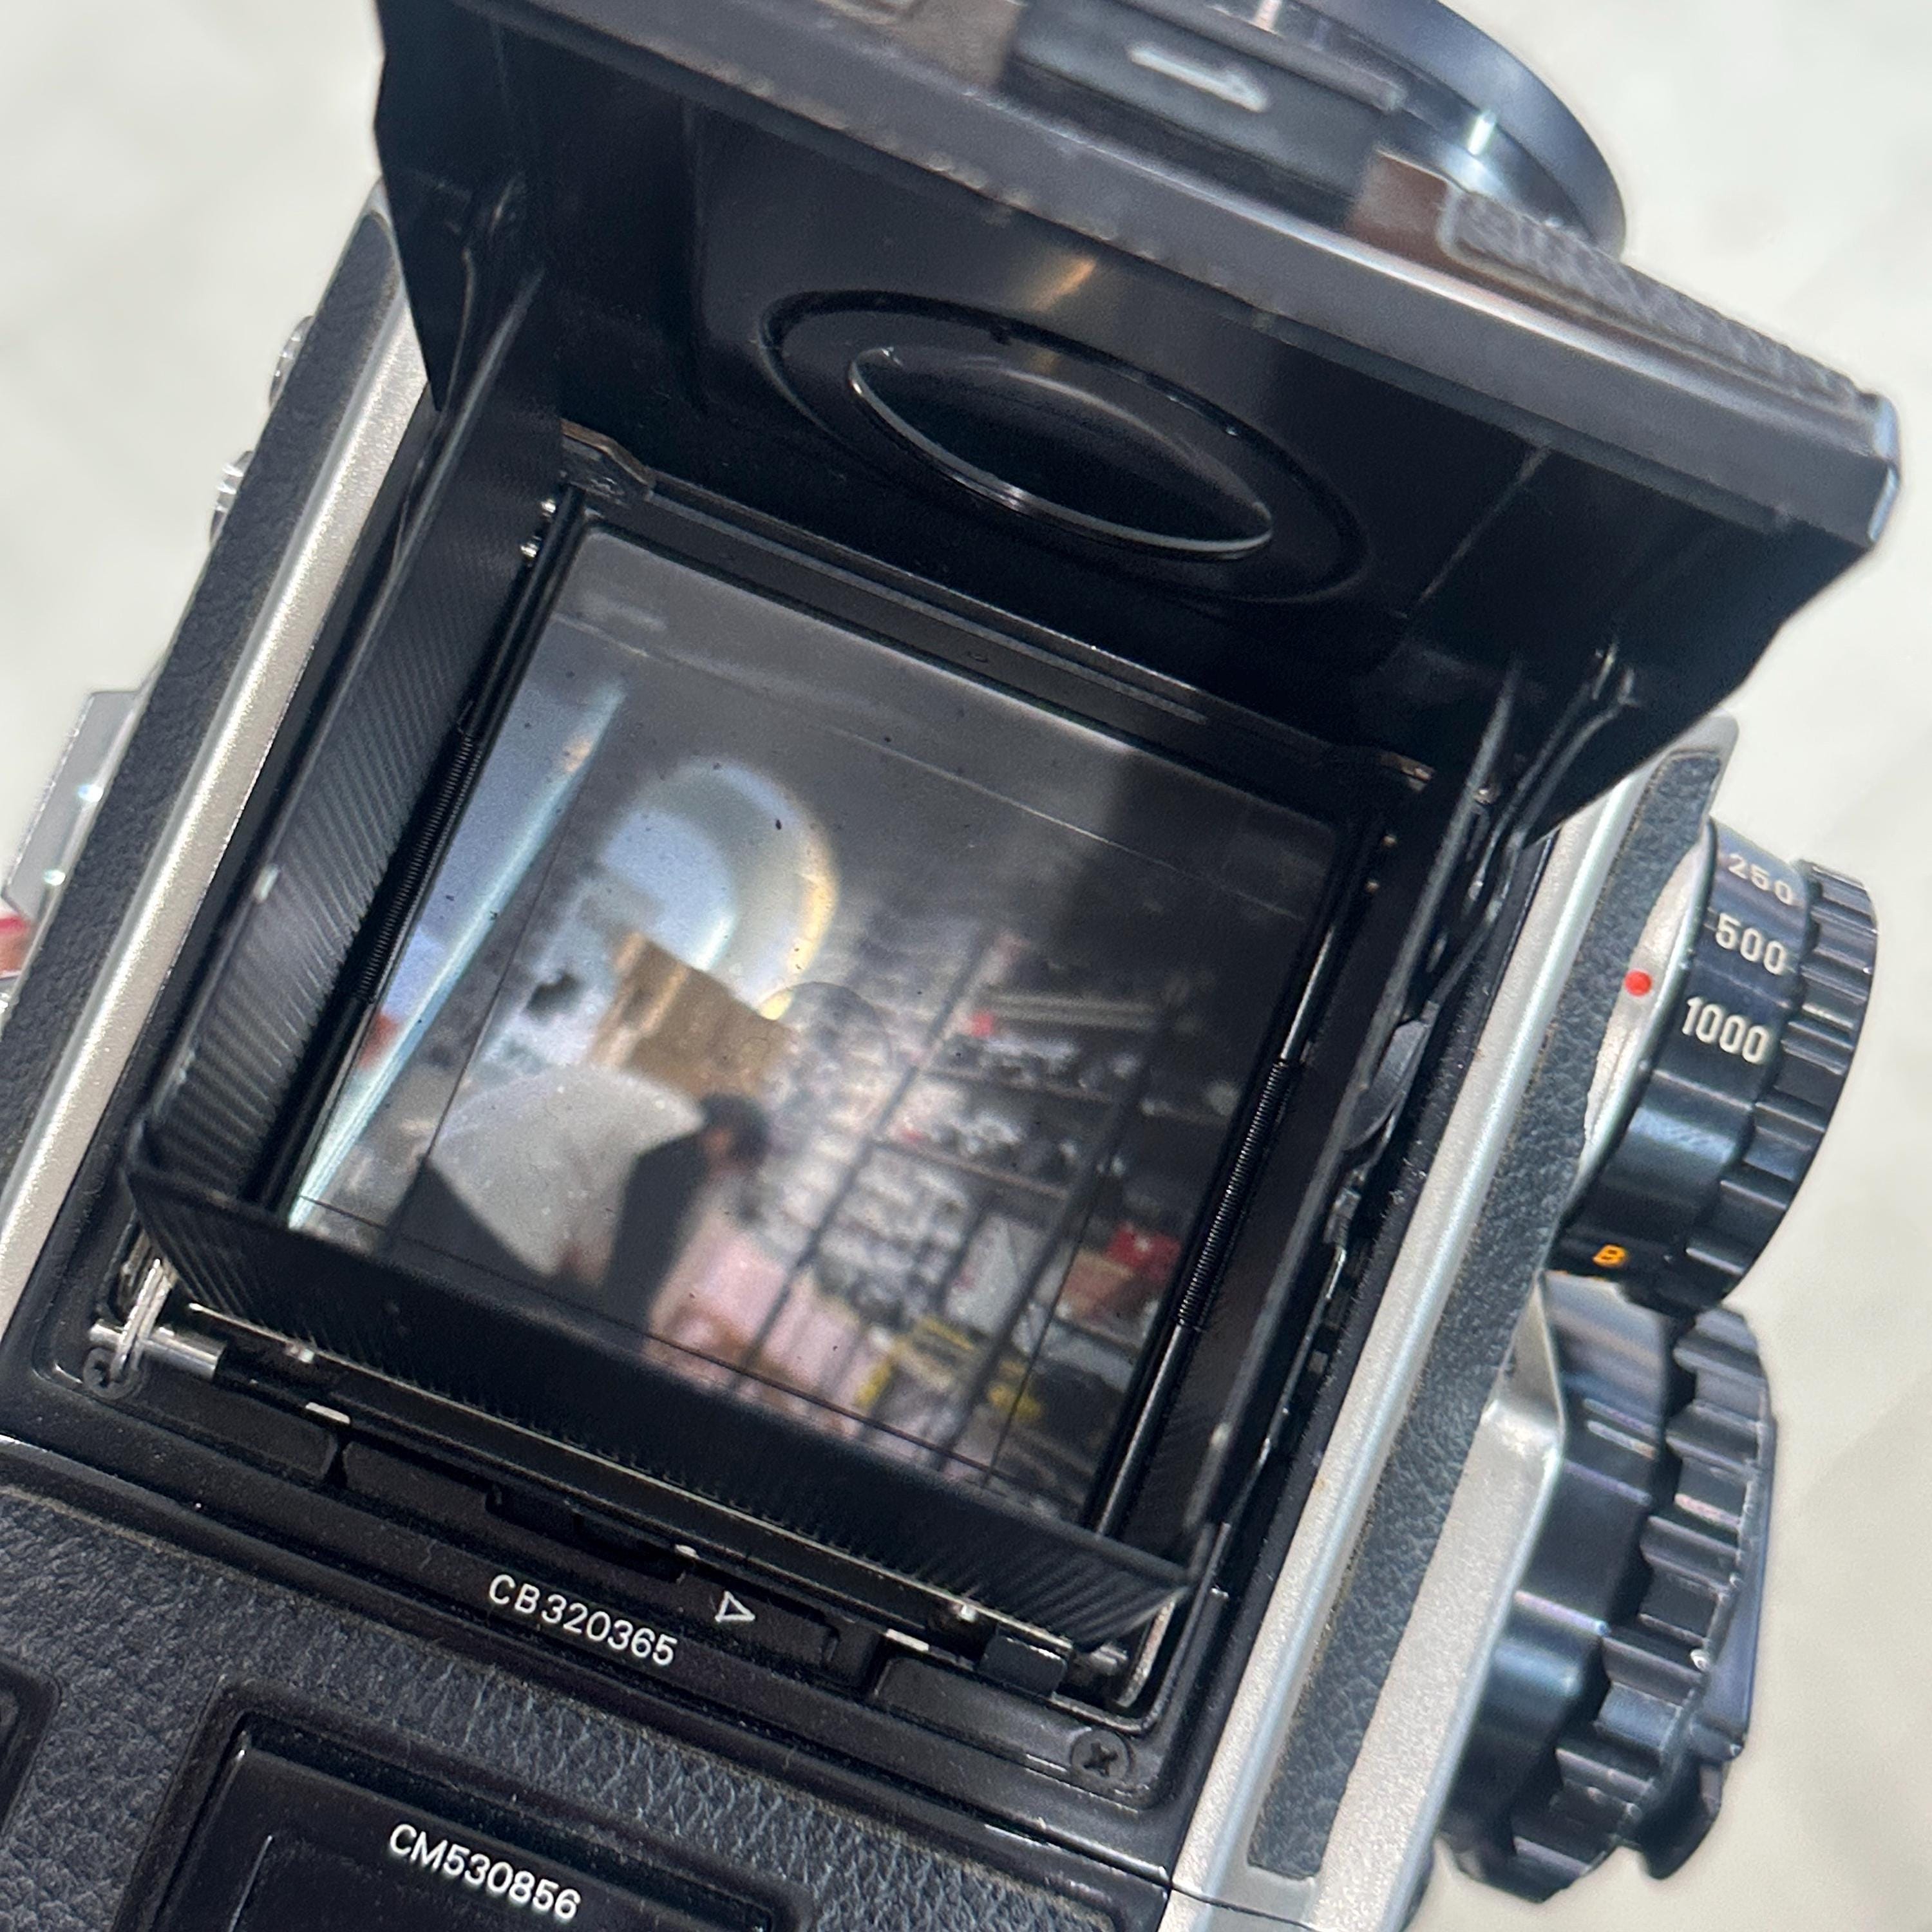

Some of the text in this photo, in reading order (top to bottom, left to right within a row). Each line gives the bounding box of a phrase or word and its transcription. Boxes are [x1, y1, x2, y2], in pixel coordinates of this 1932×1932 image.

[1728, 853, 1793, 905] 250
[1715, 913, 1786, 975] 500
[1682, 996, 1769, 1064] 1000
[1593, 1244, 1627, 1267] B
[488, 1574, 679, 1667] CB320365
[388, 1823, 582, 1921] CM530856
